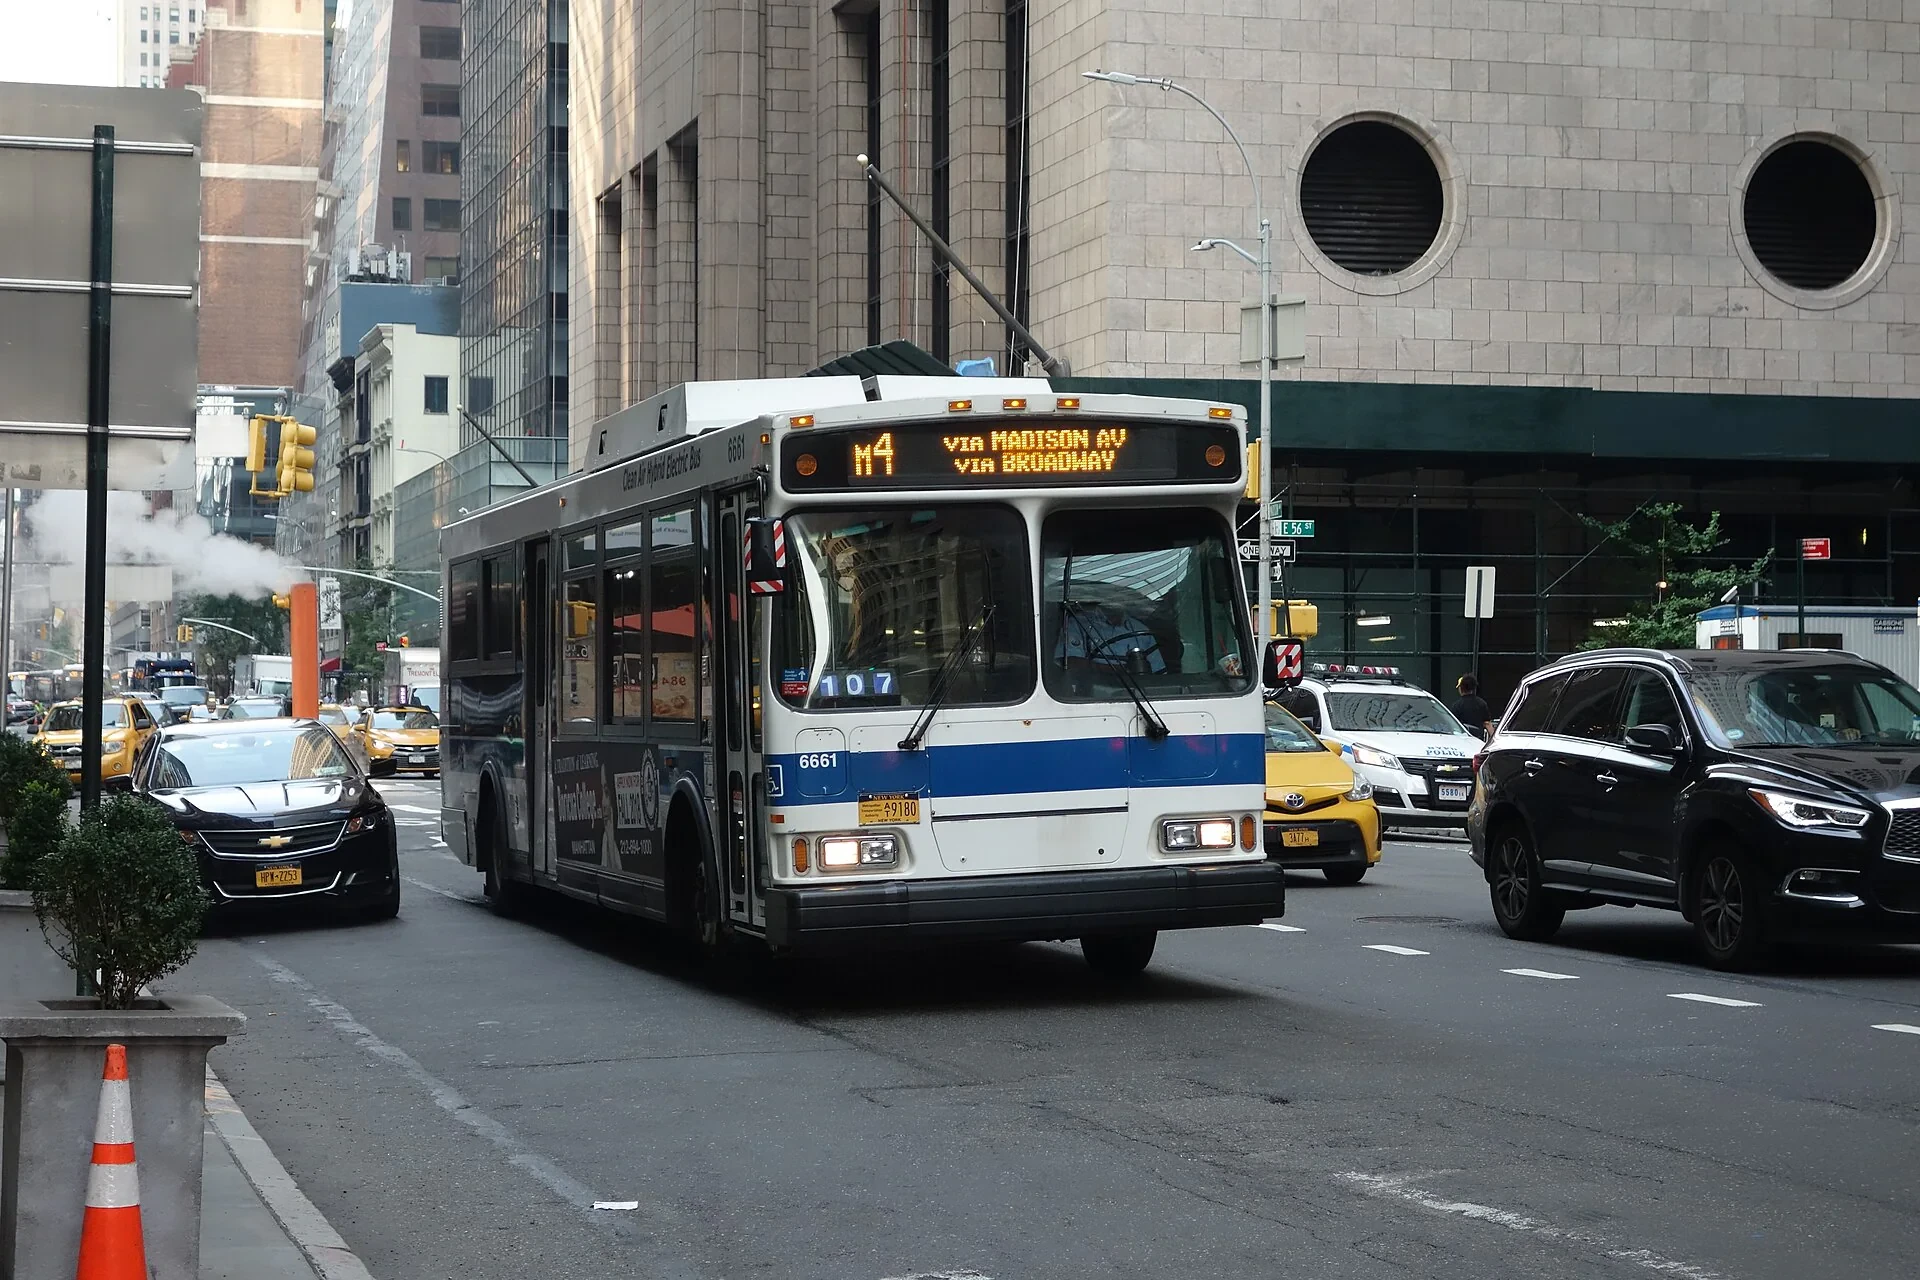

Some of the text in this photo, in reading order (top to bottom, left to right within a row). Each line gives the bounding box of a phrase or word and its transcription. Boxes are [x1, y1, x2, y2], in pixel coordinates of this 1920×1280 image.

[991, 429, 1089, 450] MADISON
[1097, 428, 1126, 448] AV
[727, 434, 745, 463] 6661
[854, 432, 893, 475] M4
[622, 445, 701, 492] Clean Air Hybrid Electric Bus
[1002, 452, 1115, 472] BROADWAY
[1284, 523, 1288, 534] E
[1291, 523, 1302, 534] 56
[1243, 546, 1259, 554] ONE
[799, 753, 837, 769] 6661
[1426, 749, 1466, 757] POLICE
[891, 801, 916, 817] 9180
